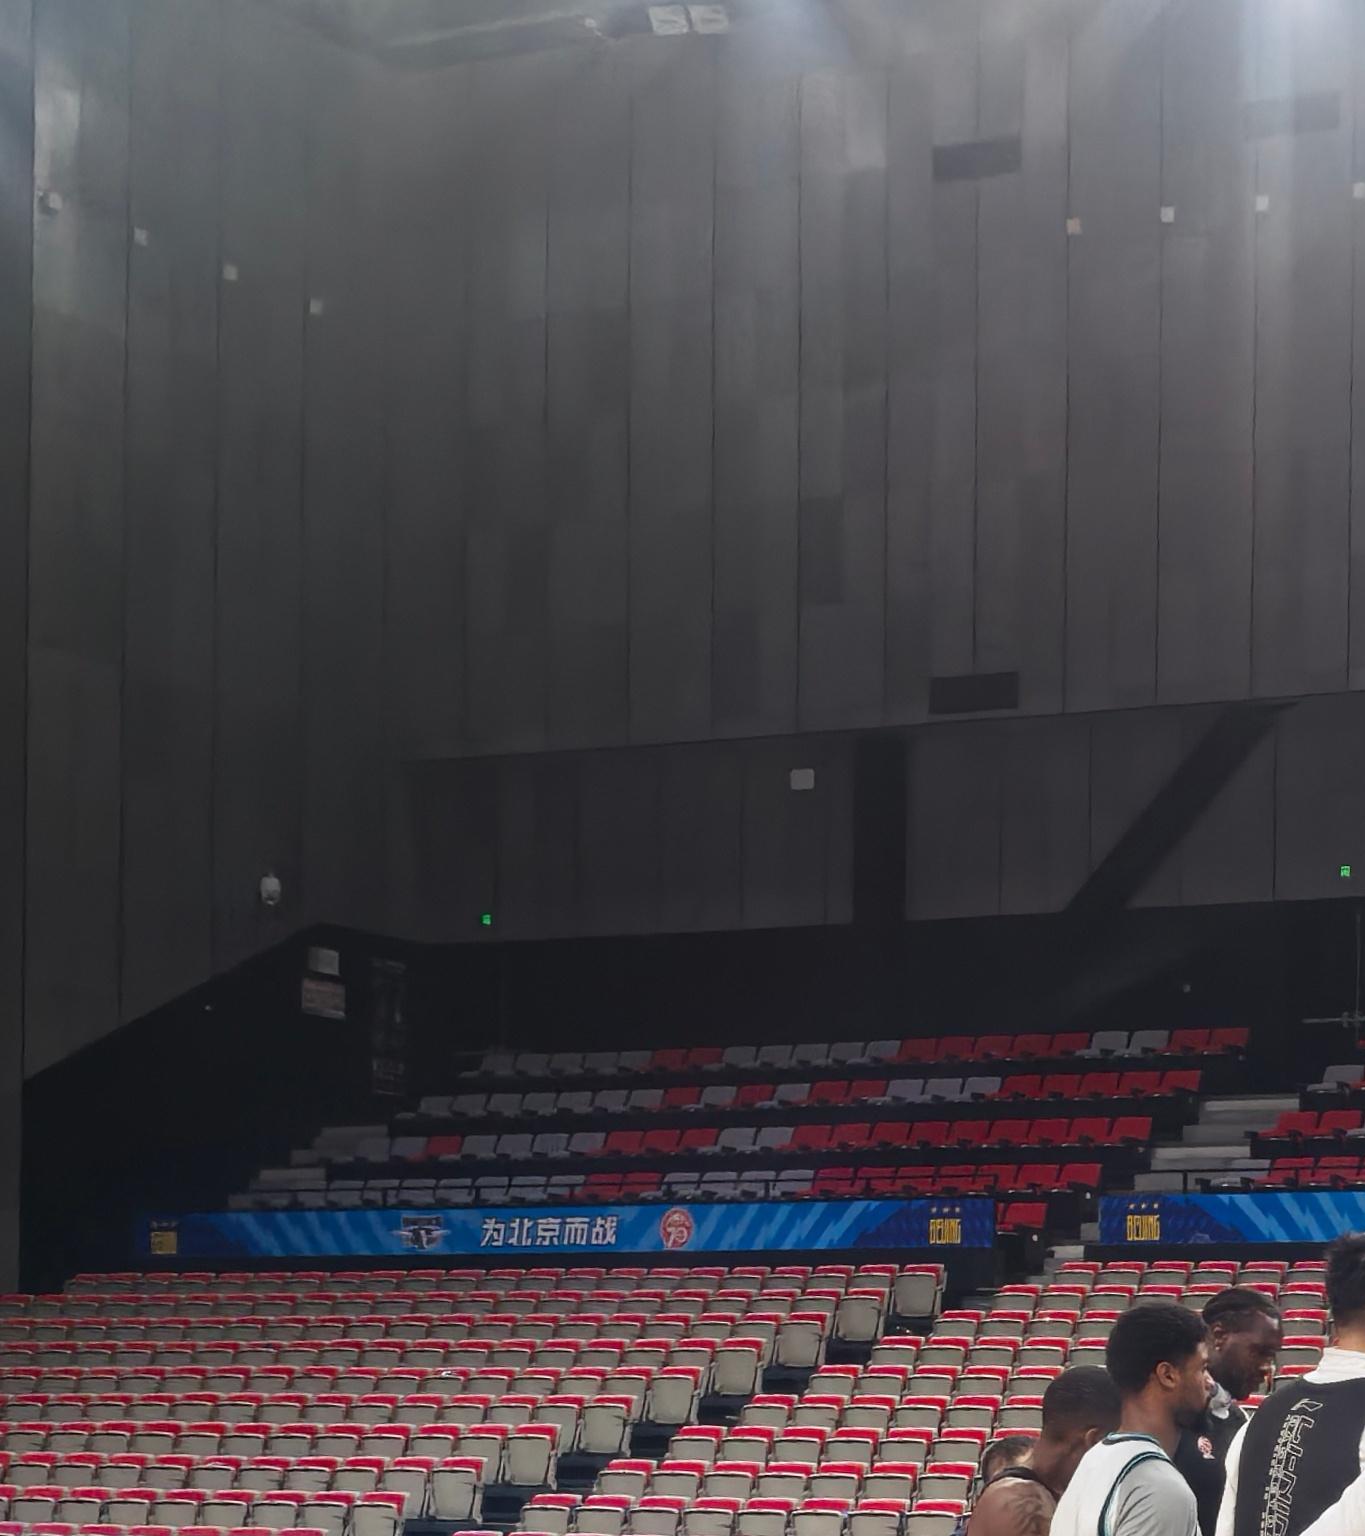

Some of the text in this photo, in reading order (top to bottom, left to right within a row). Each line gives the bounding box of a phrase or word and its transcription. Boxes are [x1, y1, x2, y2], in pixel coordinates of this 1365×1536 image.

[480, 1215, 618, 1248] 为北京而战
[928, 1218, 962, 1244] BEIJING
[1126, 1214, 1161, 1241] BEIJING
